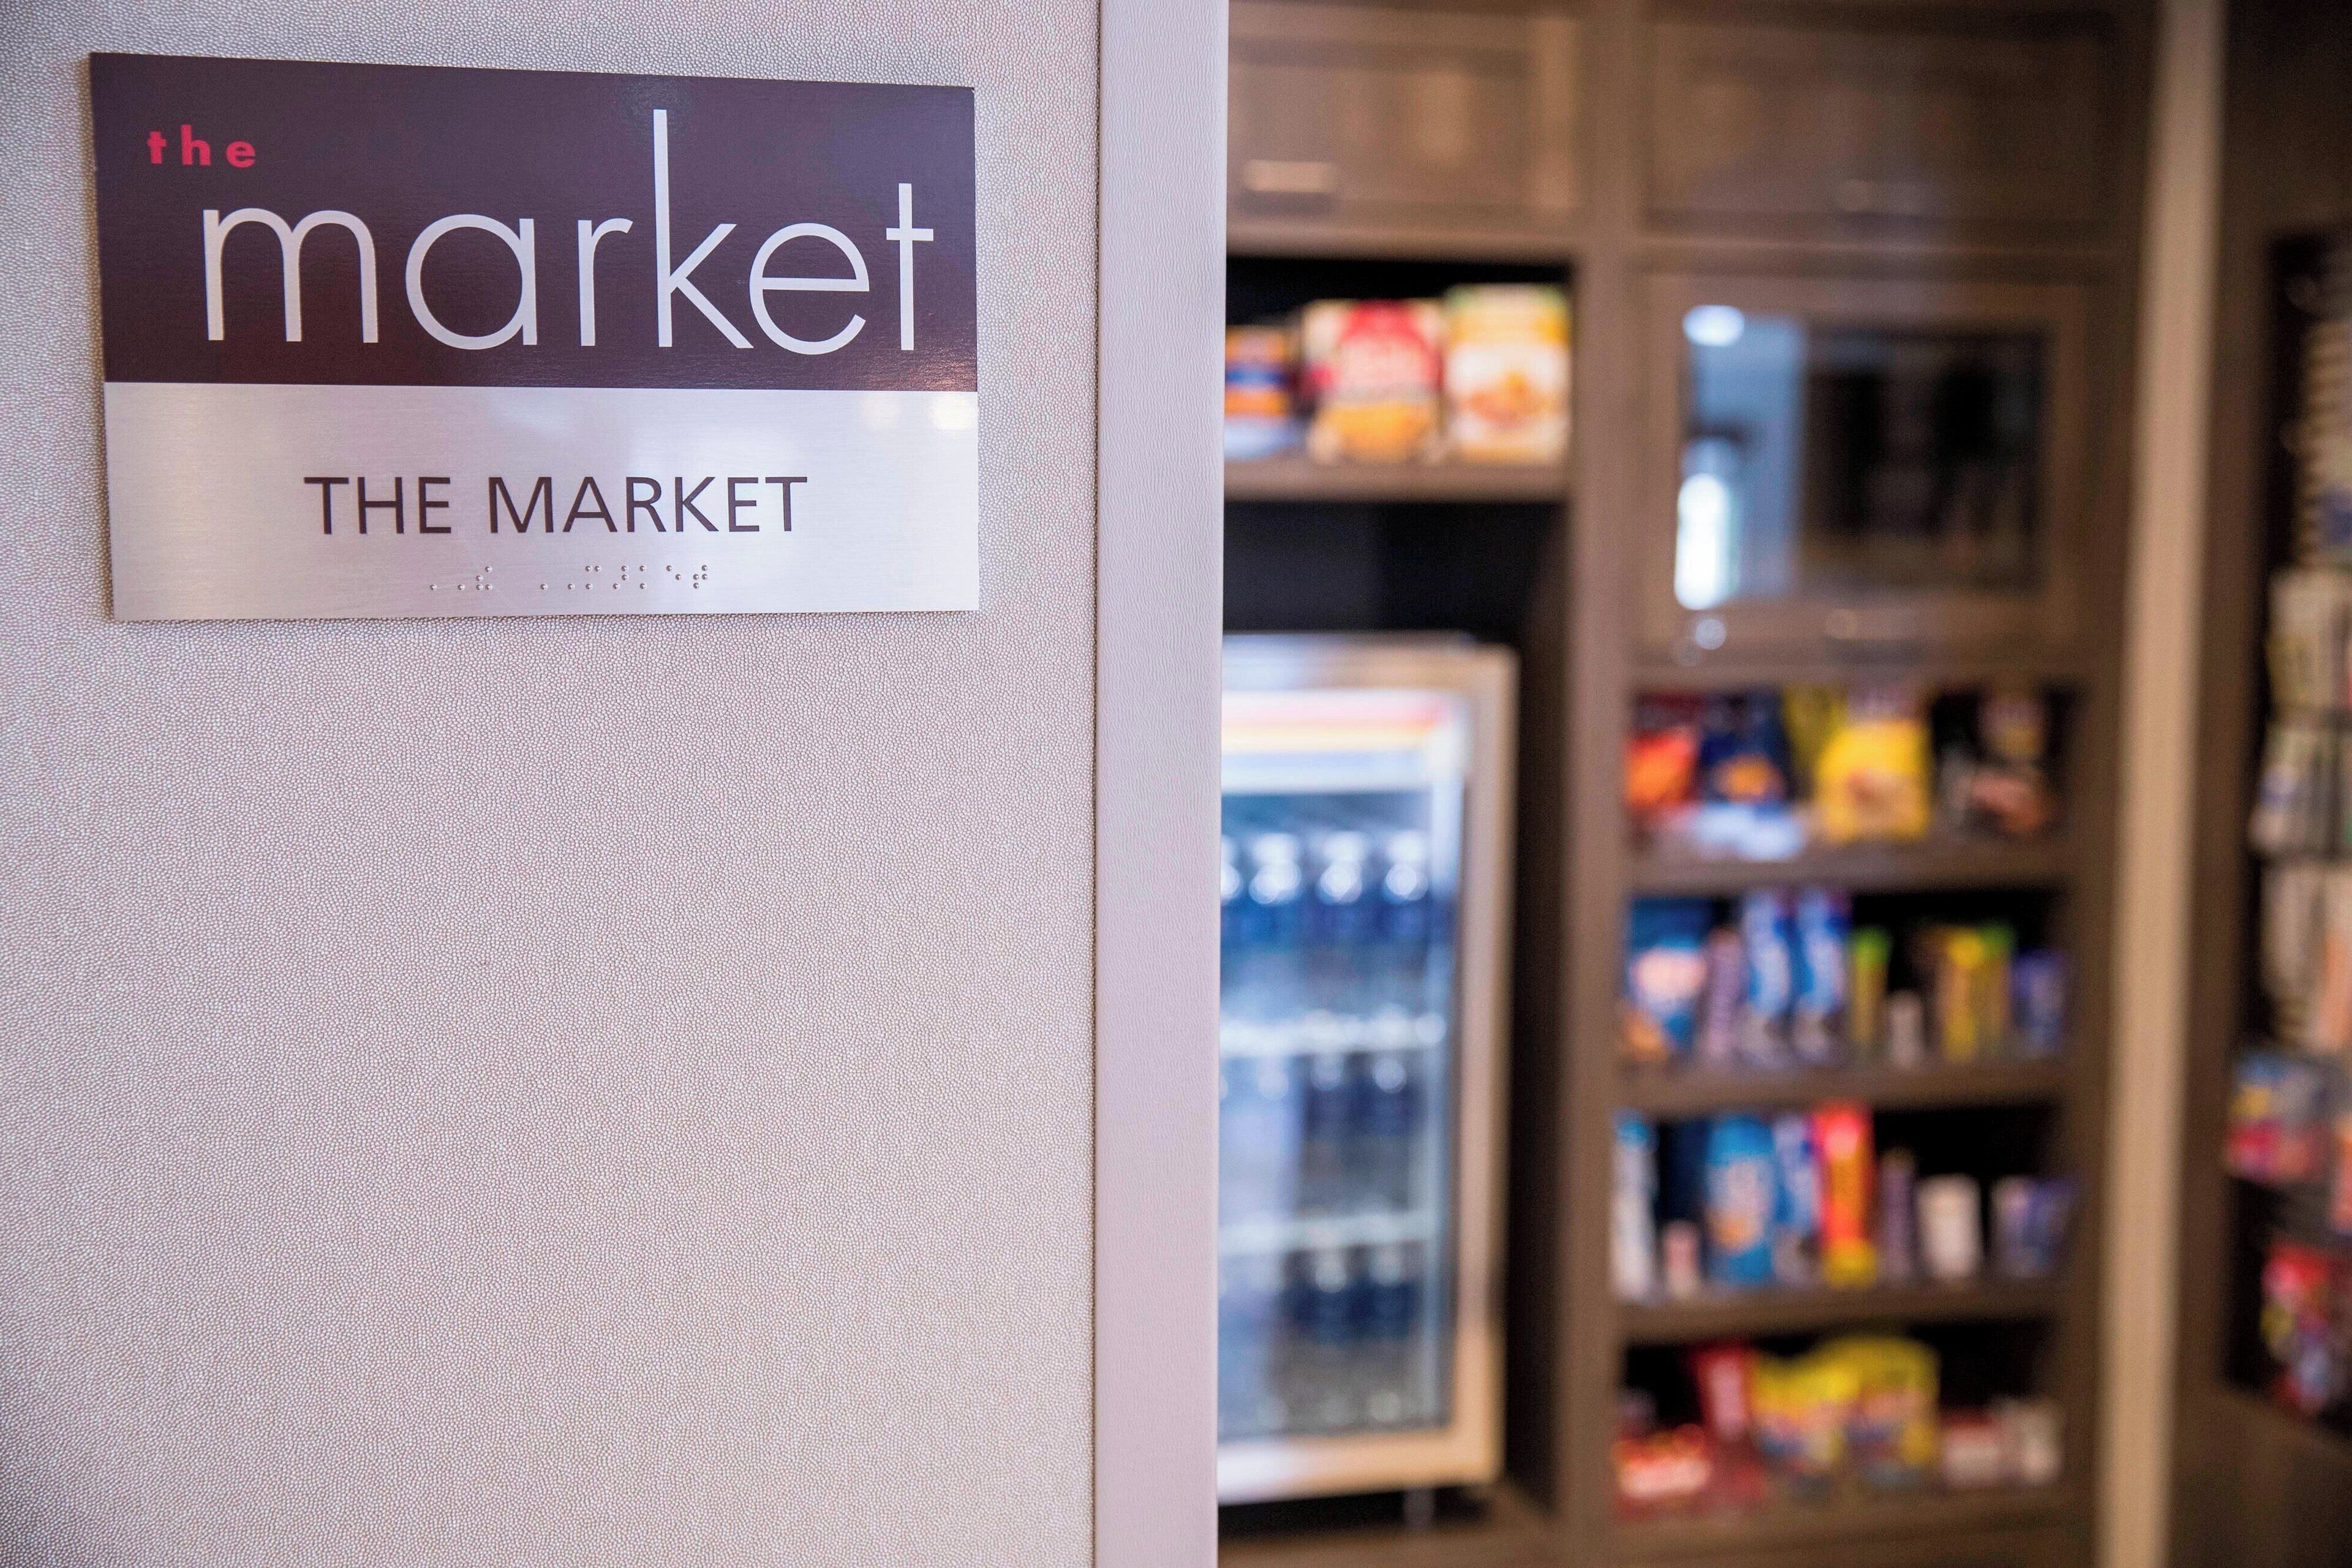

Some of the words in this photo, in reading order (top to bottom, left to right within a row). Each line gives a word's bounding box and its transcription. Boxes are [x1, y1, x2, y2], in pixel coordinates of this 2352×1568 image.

[147, 124, 255, 168] the
[203, 108, 934, 355] market
[303, 476, 452, 535] THE
[488, 476, 807, 534] MARKET
